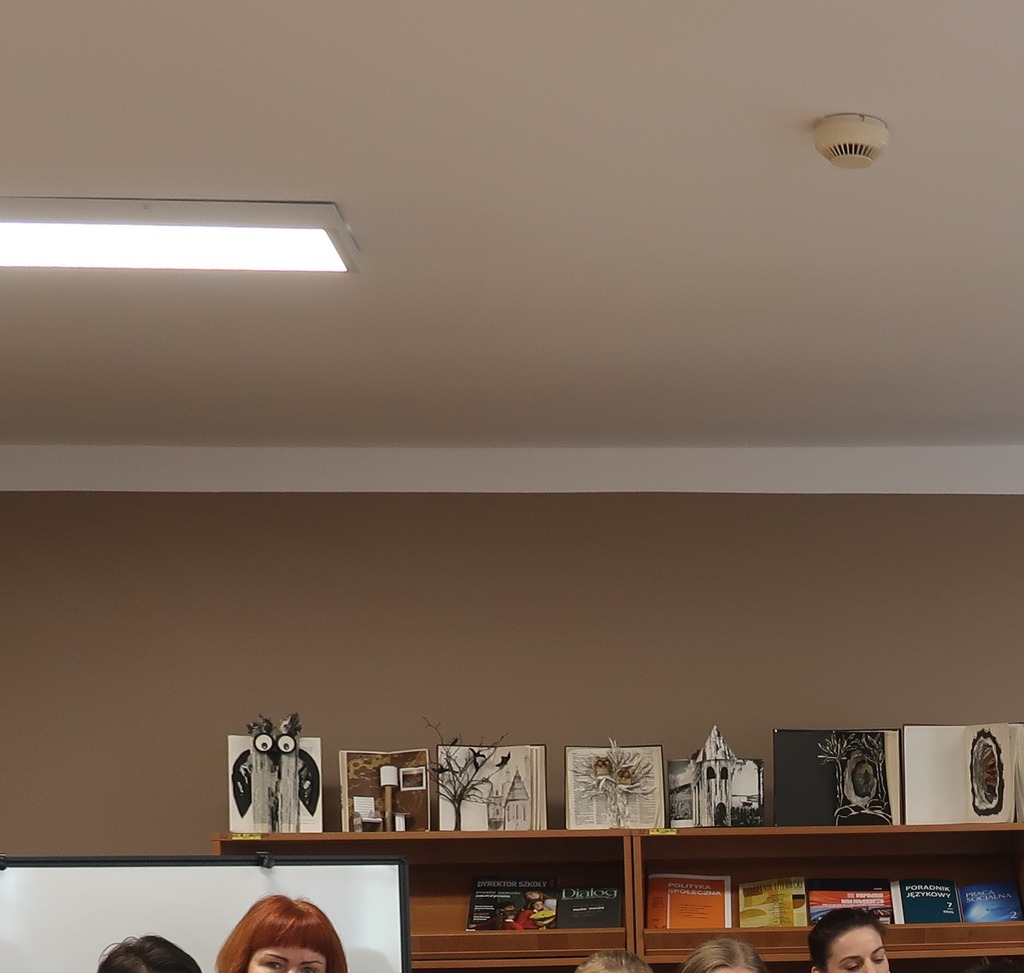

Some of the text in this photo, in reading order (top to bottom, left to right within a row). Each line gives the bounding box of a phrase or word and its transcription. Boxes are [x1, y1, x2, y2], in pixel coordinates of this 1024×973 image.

[477, 880, 517, 888] DYREKTOR
[667, 882, 711, 890] POLITYKA
[905, 884, 950, 892] PORADNIK
[561, 887, 618, 900] Dialog
[667, 888, 722, 896] SPOŁECZNA
[906, 891, 951, 899] JĘZYKOWY
[965, 889, 995, 898] PRACA
